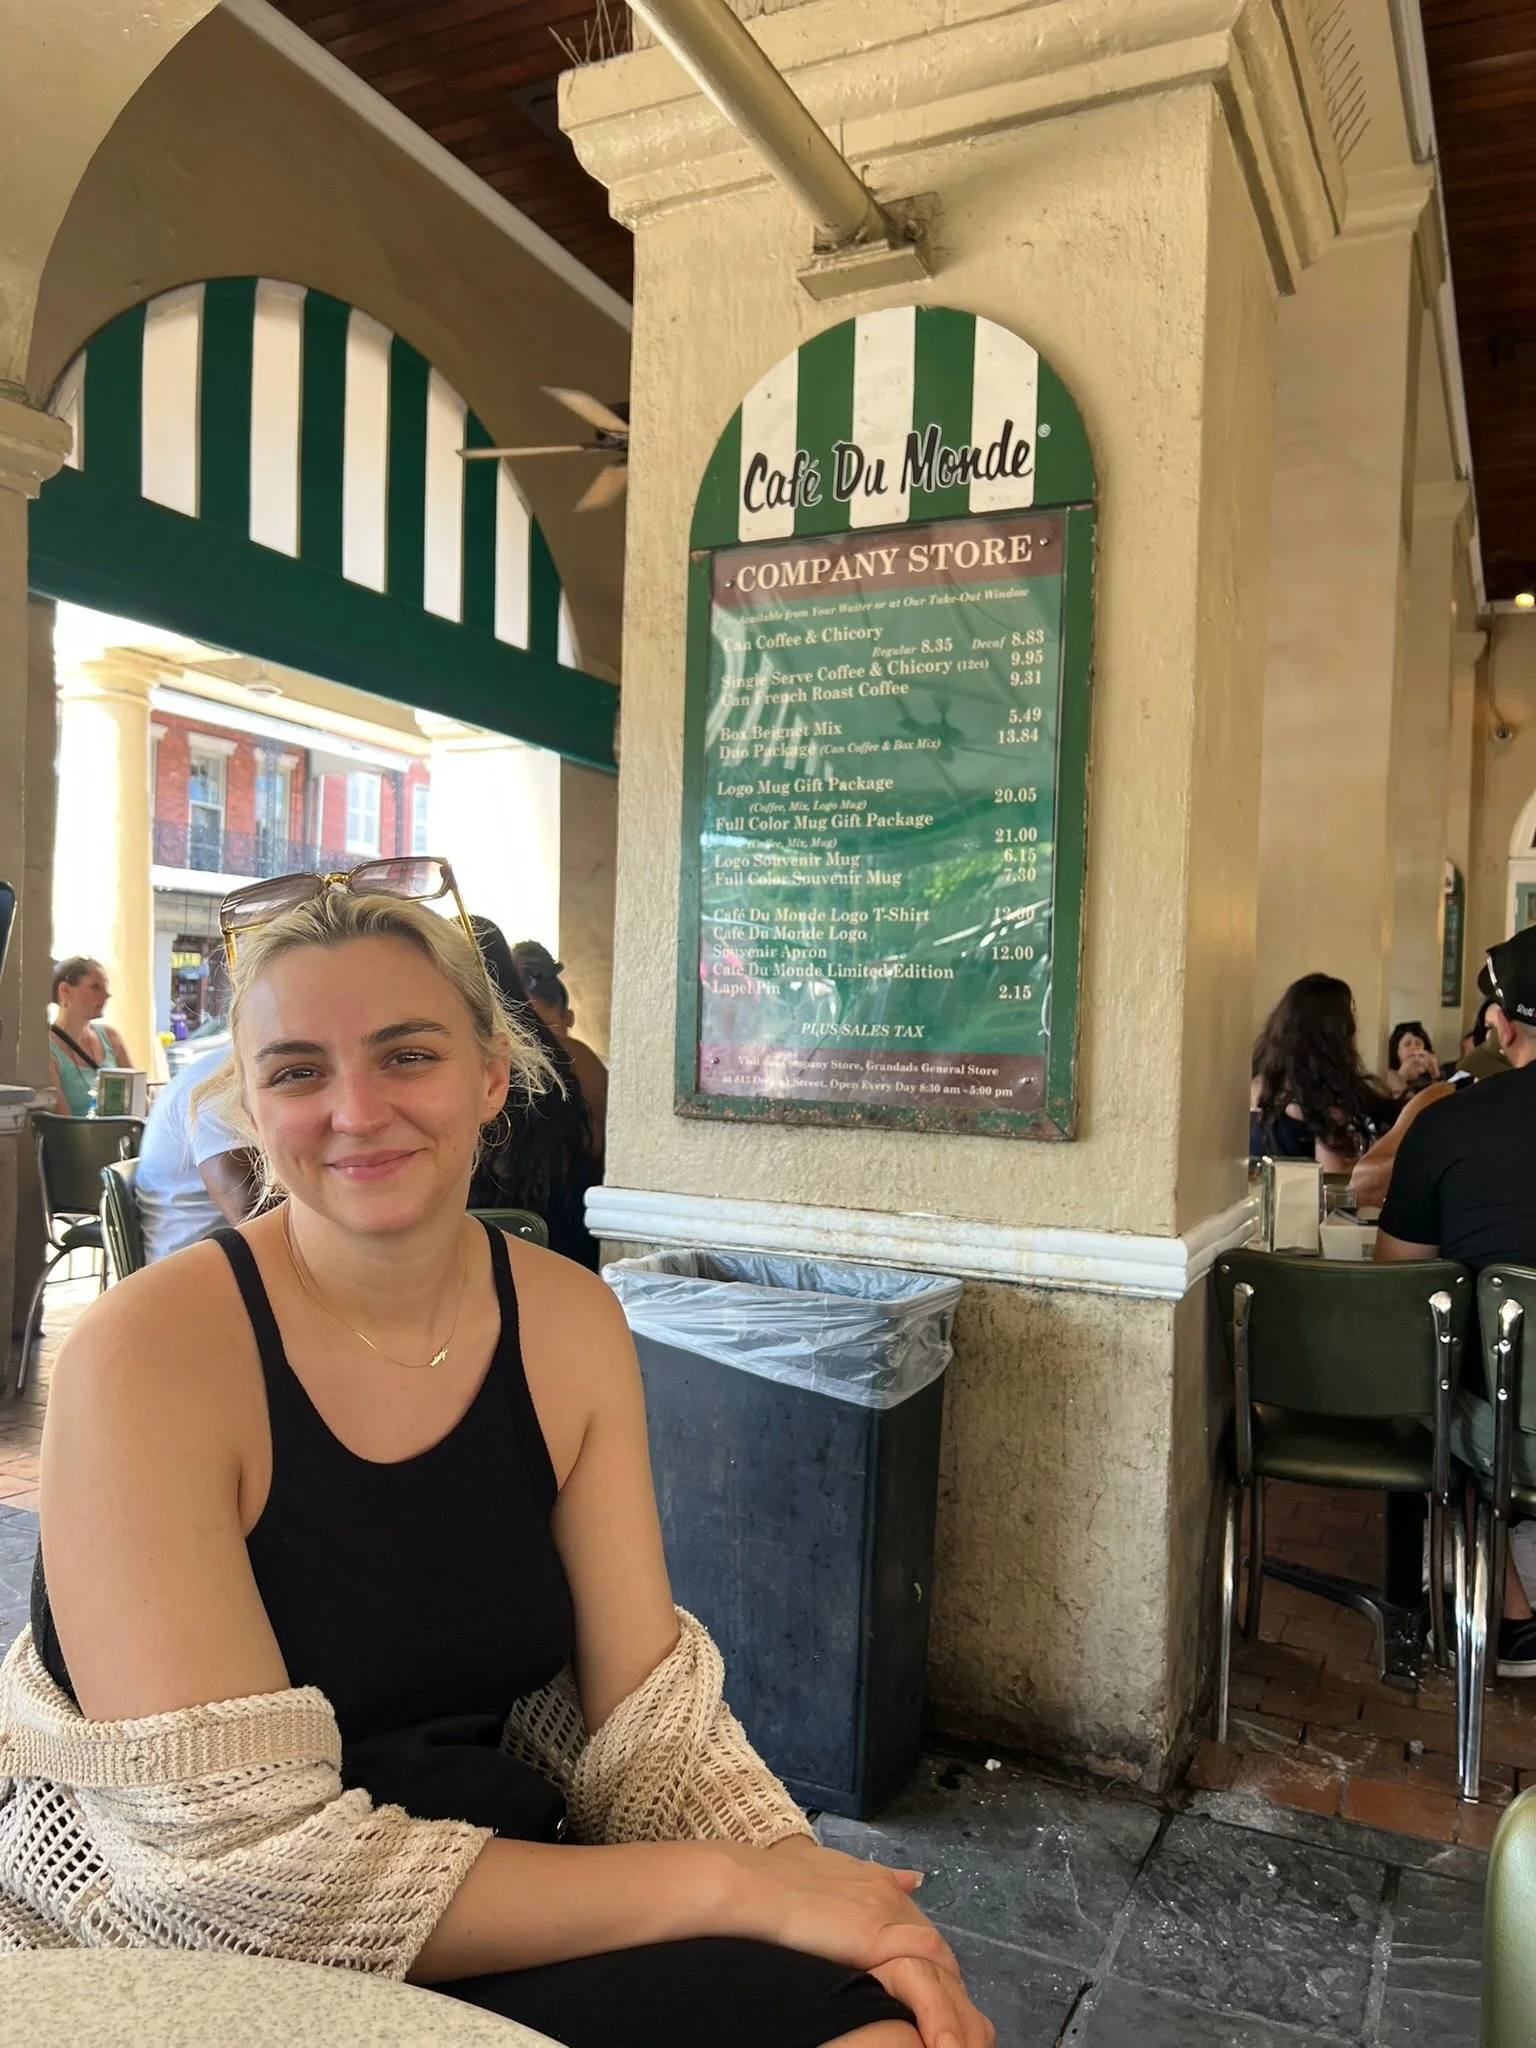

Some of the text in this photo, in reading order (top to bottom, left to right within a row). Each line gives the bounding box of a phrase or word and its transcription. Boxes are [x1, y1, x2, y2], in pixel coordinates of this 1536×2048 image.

[744, 418, 1033, 513] Café Du Monde
[736, 534, 1032, 592] COMPANY STORE
[740, 588, 1030, 625] Available from Your Waiter or at Our Take-Out Window
[723, 626, 883, 652] Can Coffee & Chicory
[872, 629, 1045, 658] Regular 8.35 Decaf 8.83
[721, 650, 1044, 690] Single Serve Coffee & Chicory (12ct) 9.95
[720, 671, 1042, 707] Can French Roast Coffee 9.31
[720, 707, 1042, 741] Box Beignet Mix 5.49
[719, 728, 1039, 760] Duo Package (Can Coffee & Box Mix) 13.84
[717, 776, 894, 797] Logo Mug Gift Package
[749, 788, 1037, 814] (Coffee, Mix, Logo Mug) 20.05
[716, 812, 934, 831] Full Color Mug Gift Package
[811, 838, 838, 848] Mug)
[995, 827, 1037, 843] 21.00
[715, 848, 1036, 869] Logo Souvenir Mug 6.15
[715, 867, 1036, 887] Full Color Souvenir Mug 7.30
[713, 908, 745, 922] Café
[750, 908, 770, 921] Du
[774, 908, 826, 922] Monde
[831, 908, 868, 923] Logo
[873, 908, 930, 922] T-Shirt
[713, 926, 867, 942] Café Du Monde Logo
[713, 944, 1034, 960] Souvenir Apron 12.00
[749, 963, 769, 976] Du
[773, 963, 823, 977] Monde
[828, 963, 888, 978] Limited
[893, 964, 955, 979] Edition
[712, 980, 1032, 999] Lapel Pin 2.15
[801, 1023, 925, 1038] PLUS SALES TAX
[831, 1060, 863, 1071] Store,
[866, 1061, 918, 1073] Grandads
[921, 1063, 965, 1075] General
[967, 1065, 999, 1076] Store
[830, 1077, 858, 1091] Open
[861, 1080, 891, 1093] Every
[895, 1082, 916, 1093] Day
[943, 1086, 961, 1095] am
[994, 1087, 1013, 1098] pm
